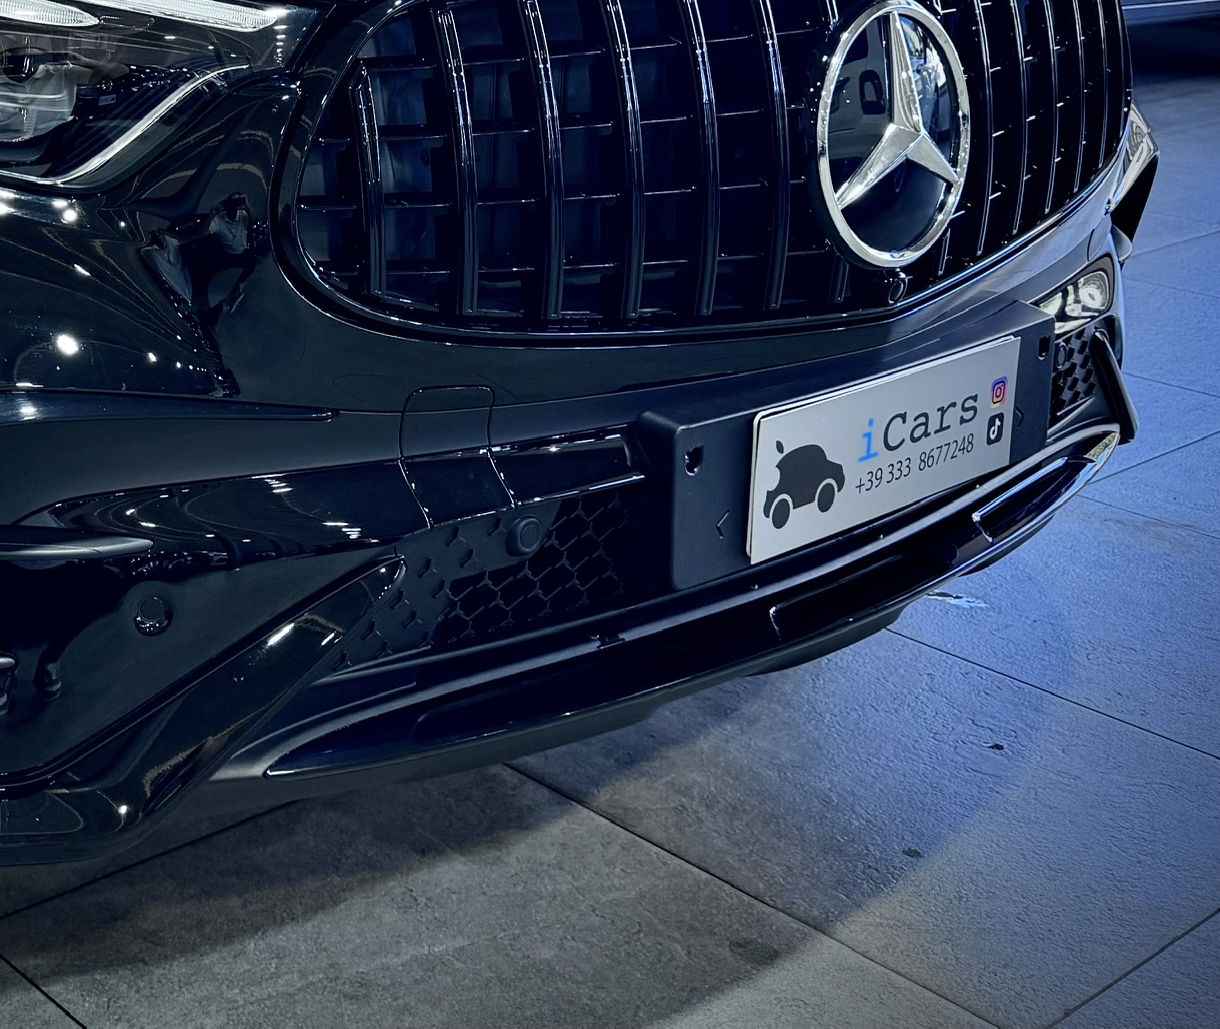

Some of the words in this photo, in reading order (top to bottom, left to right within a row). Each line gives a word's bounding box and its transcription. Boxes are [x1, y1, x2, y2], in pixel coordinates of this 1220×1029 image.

[857, 393, 979, 463] iCars
[855, 468, 883, 494] +39
[886, 457, 912, 484] 333
[918, 433, 974, 471] 8677248
